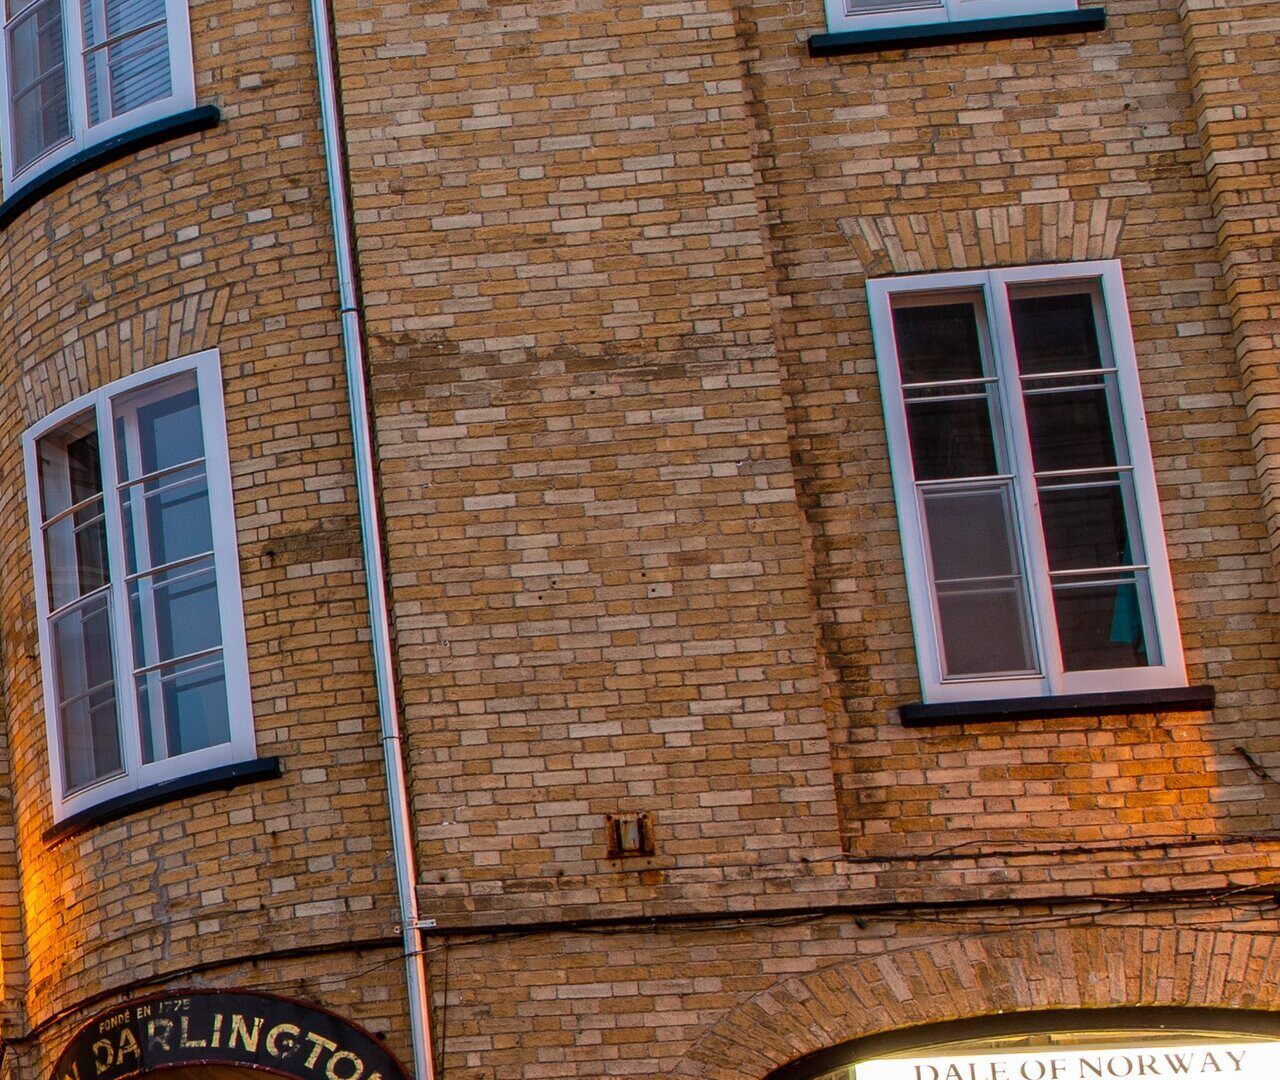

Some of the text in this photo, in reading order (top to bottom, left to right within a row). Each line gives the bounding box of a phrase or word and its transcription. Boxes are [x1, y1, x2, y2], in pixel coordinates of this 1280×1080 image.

[99, 998, 191, 1035] FONDÉ EN 1775
[1079, 1050, 1247, 1080] NORWAY
